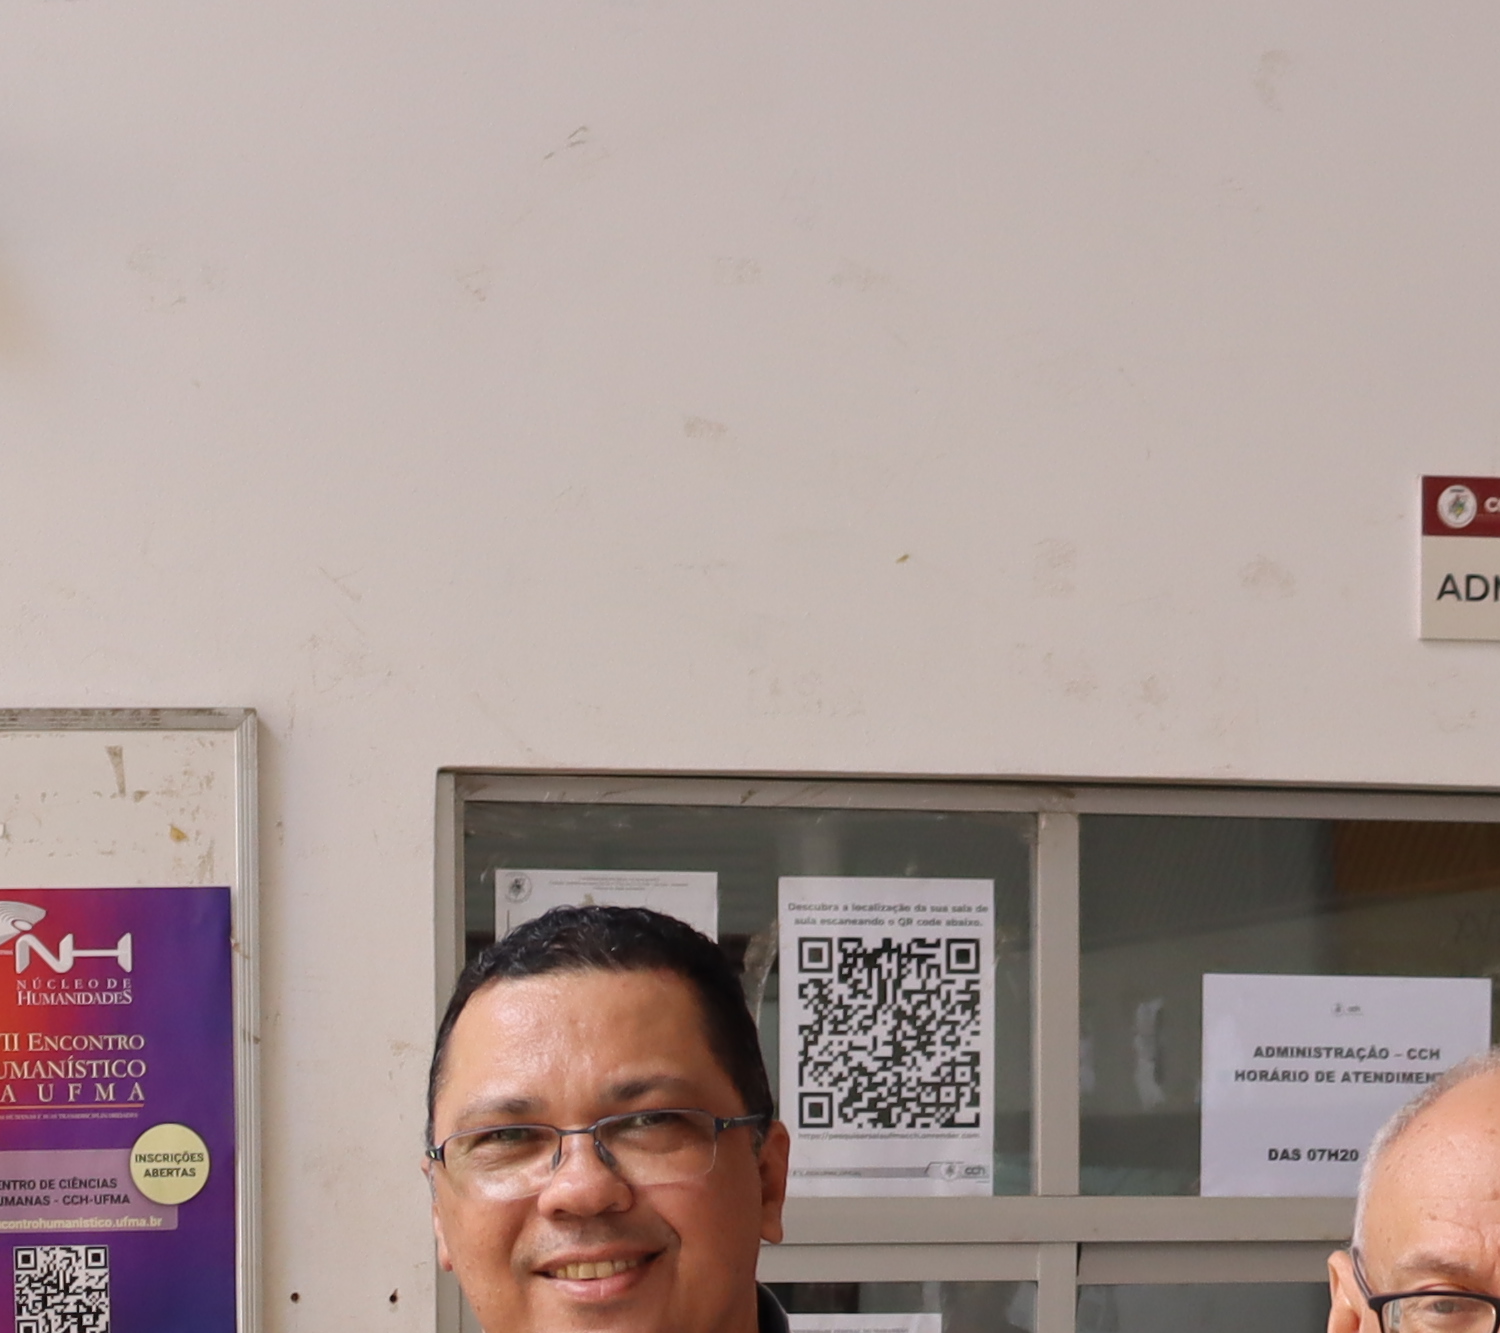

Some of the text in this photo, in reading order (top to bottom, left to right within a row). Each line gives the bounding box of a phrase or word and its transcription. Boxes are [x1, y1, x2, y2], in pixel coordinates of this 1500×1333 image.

[788, 903, 839, 911] Descubra
[852, 903, 910, 914] localização
[914, 904, 926, 912] da
[952, 904, 972, 912] sala
[976, 904, 988, 912] de
[18, 977, 131, 990] NÚCLEO DE
[1253, 1046, 1389, 1062] ADMINISTRAÇÃO
[1407, 1049, 1440, 1060] CCH
[1234, 1068, 1309, 1082] HORÁRIO
[1315, 1071, 1335, 1082] DE
[38, 1082, 145, 1102] UFMA
[135, 1152, 204, 1165] INSCRIÇÕES
[1268, 1149, 1359, 1161] DAS 07H20
[144, 1167, 196, 1178] ABERTAS
[39, 1178, 55, 1190] DE
[59, 1176, 117, 1189] CIÊNCIAS
[62, 1194, 130, 1206] CCH-UFMA
